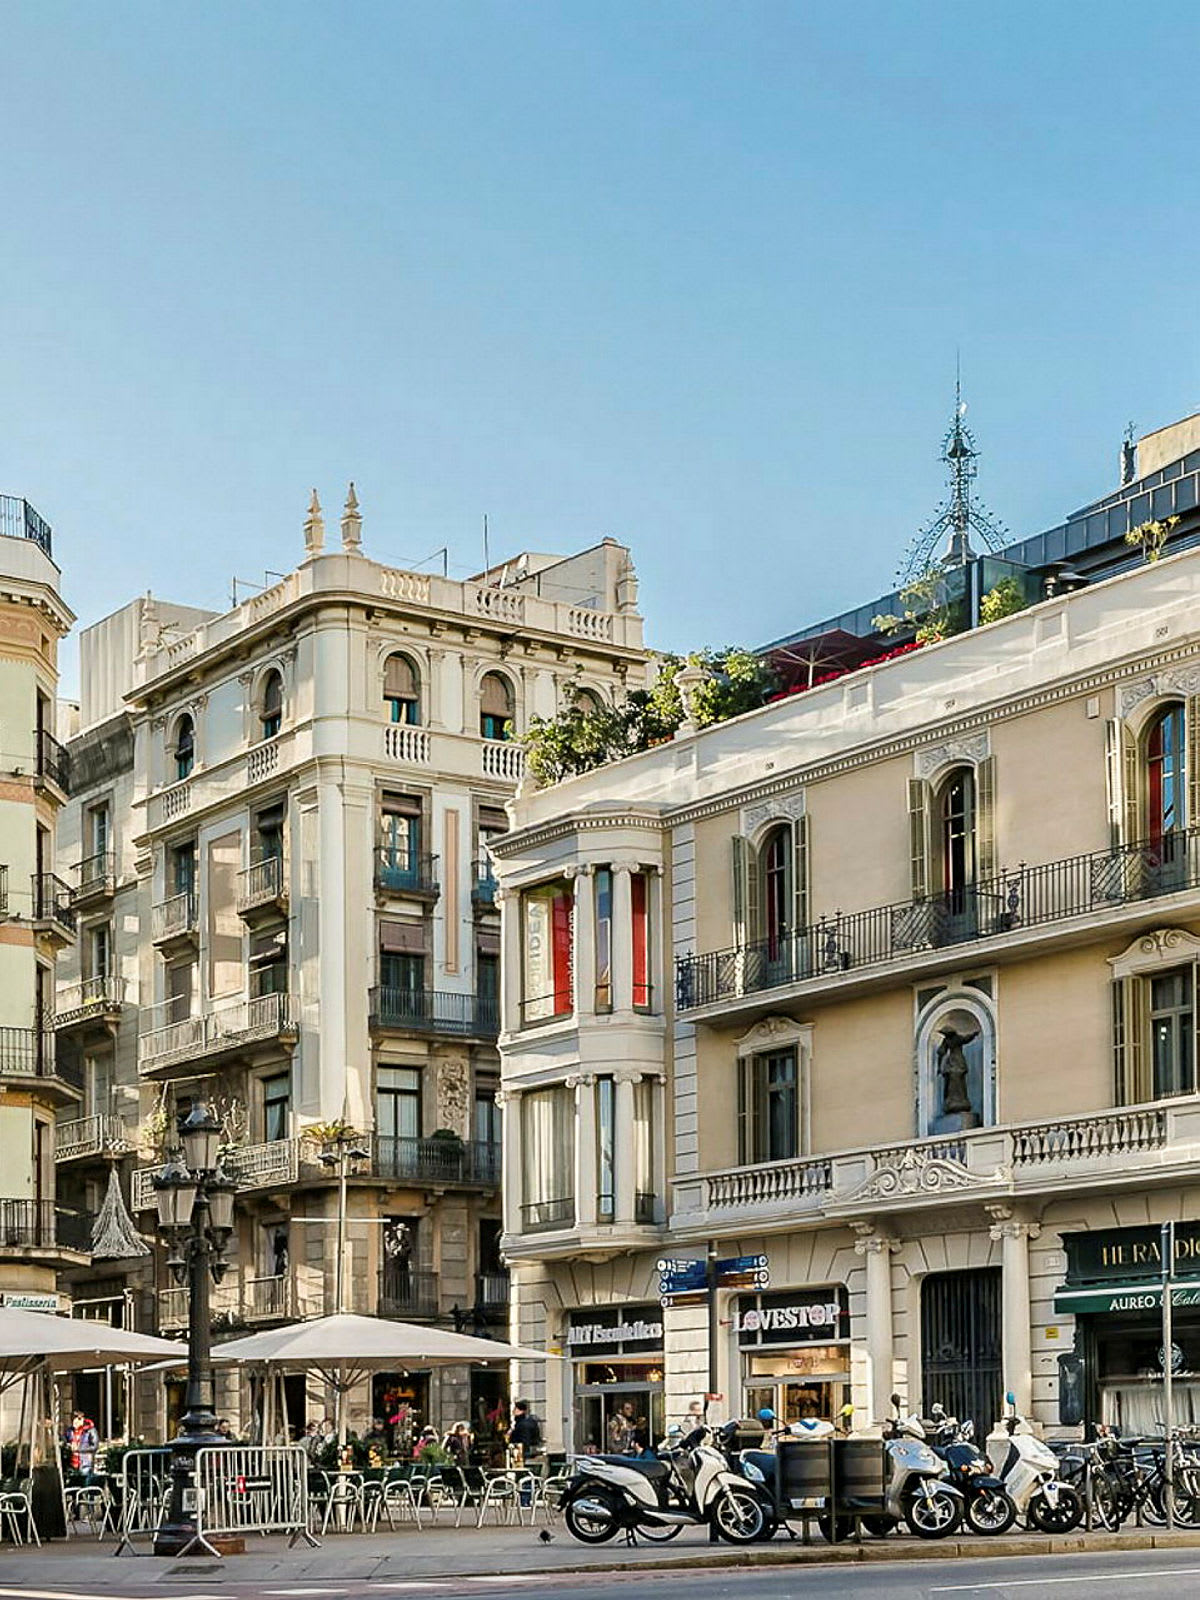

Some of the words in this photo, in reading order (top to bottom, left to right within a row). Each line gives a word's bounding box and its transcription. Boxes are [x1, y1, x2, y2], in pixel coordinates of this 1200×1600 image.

[1102, 1237, 1200, 1267] HERADI
[732, 1302, 841, 1332] LOVESTOP
[1109, 1295, 1156, 1311] AUREO
